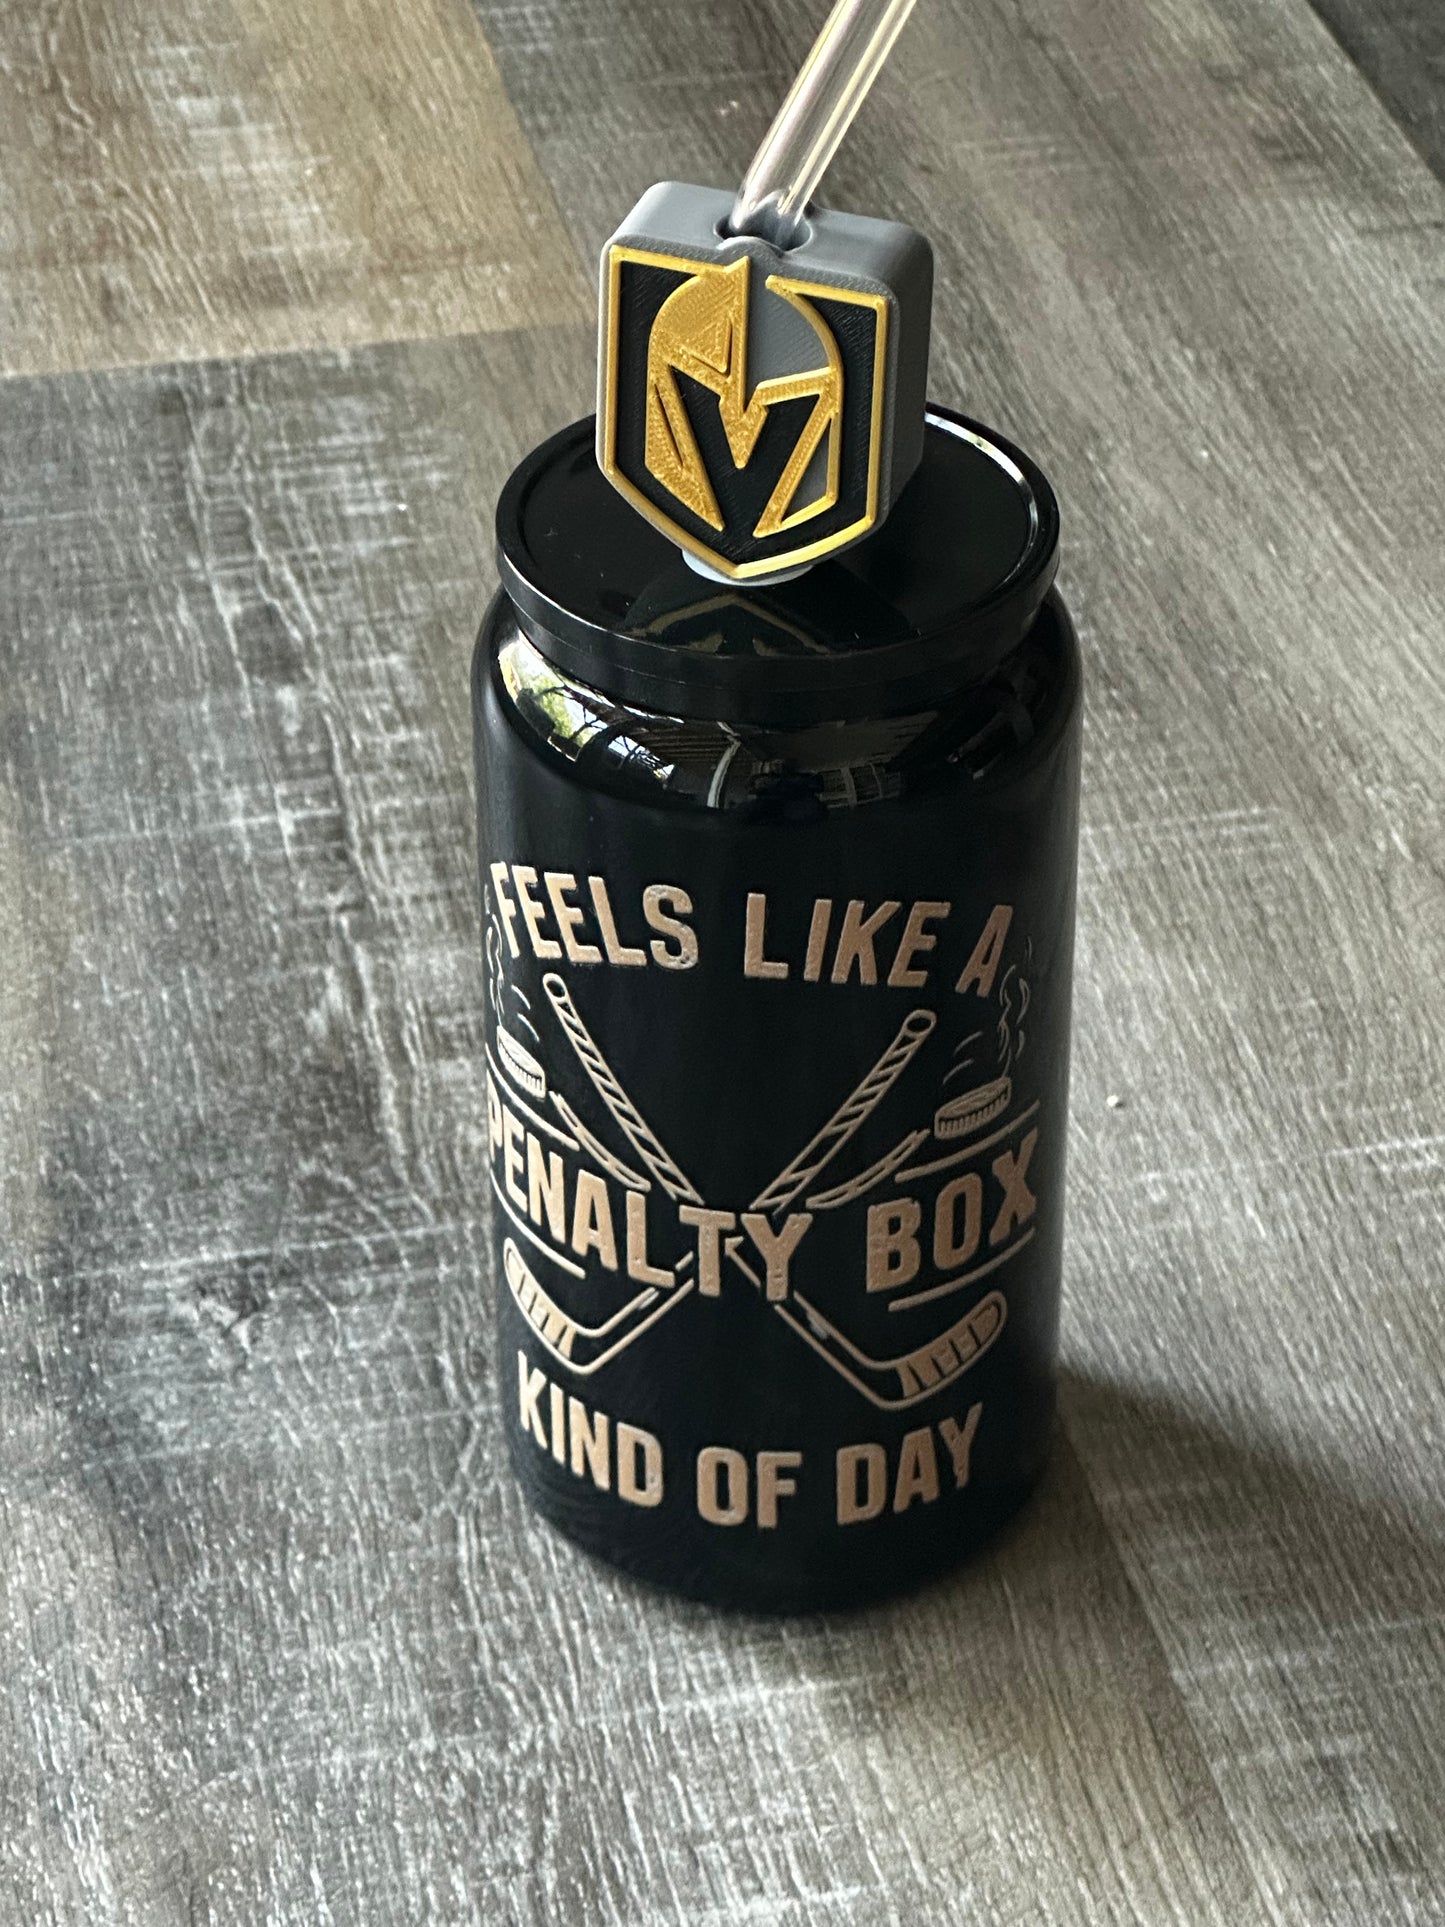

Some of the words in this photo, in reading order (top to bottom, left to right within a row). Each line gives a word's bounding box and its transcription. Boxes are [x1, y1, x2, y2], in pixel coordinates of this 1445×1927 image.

[490, 861, 698, 970] FEELS
[744, 893, 950, 987] LIKE
[955, 904, 1013, 998] A
[486, 1070, 812, 1300] PENALTY
[866, 1128, 1038, 1293] BOX
[518, 1350, 663, 1507] KIND
[697, 1446, 802, 1528] OF
[836, 1402, 982, 1526] DAY
